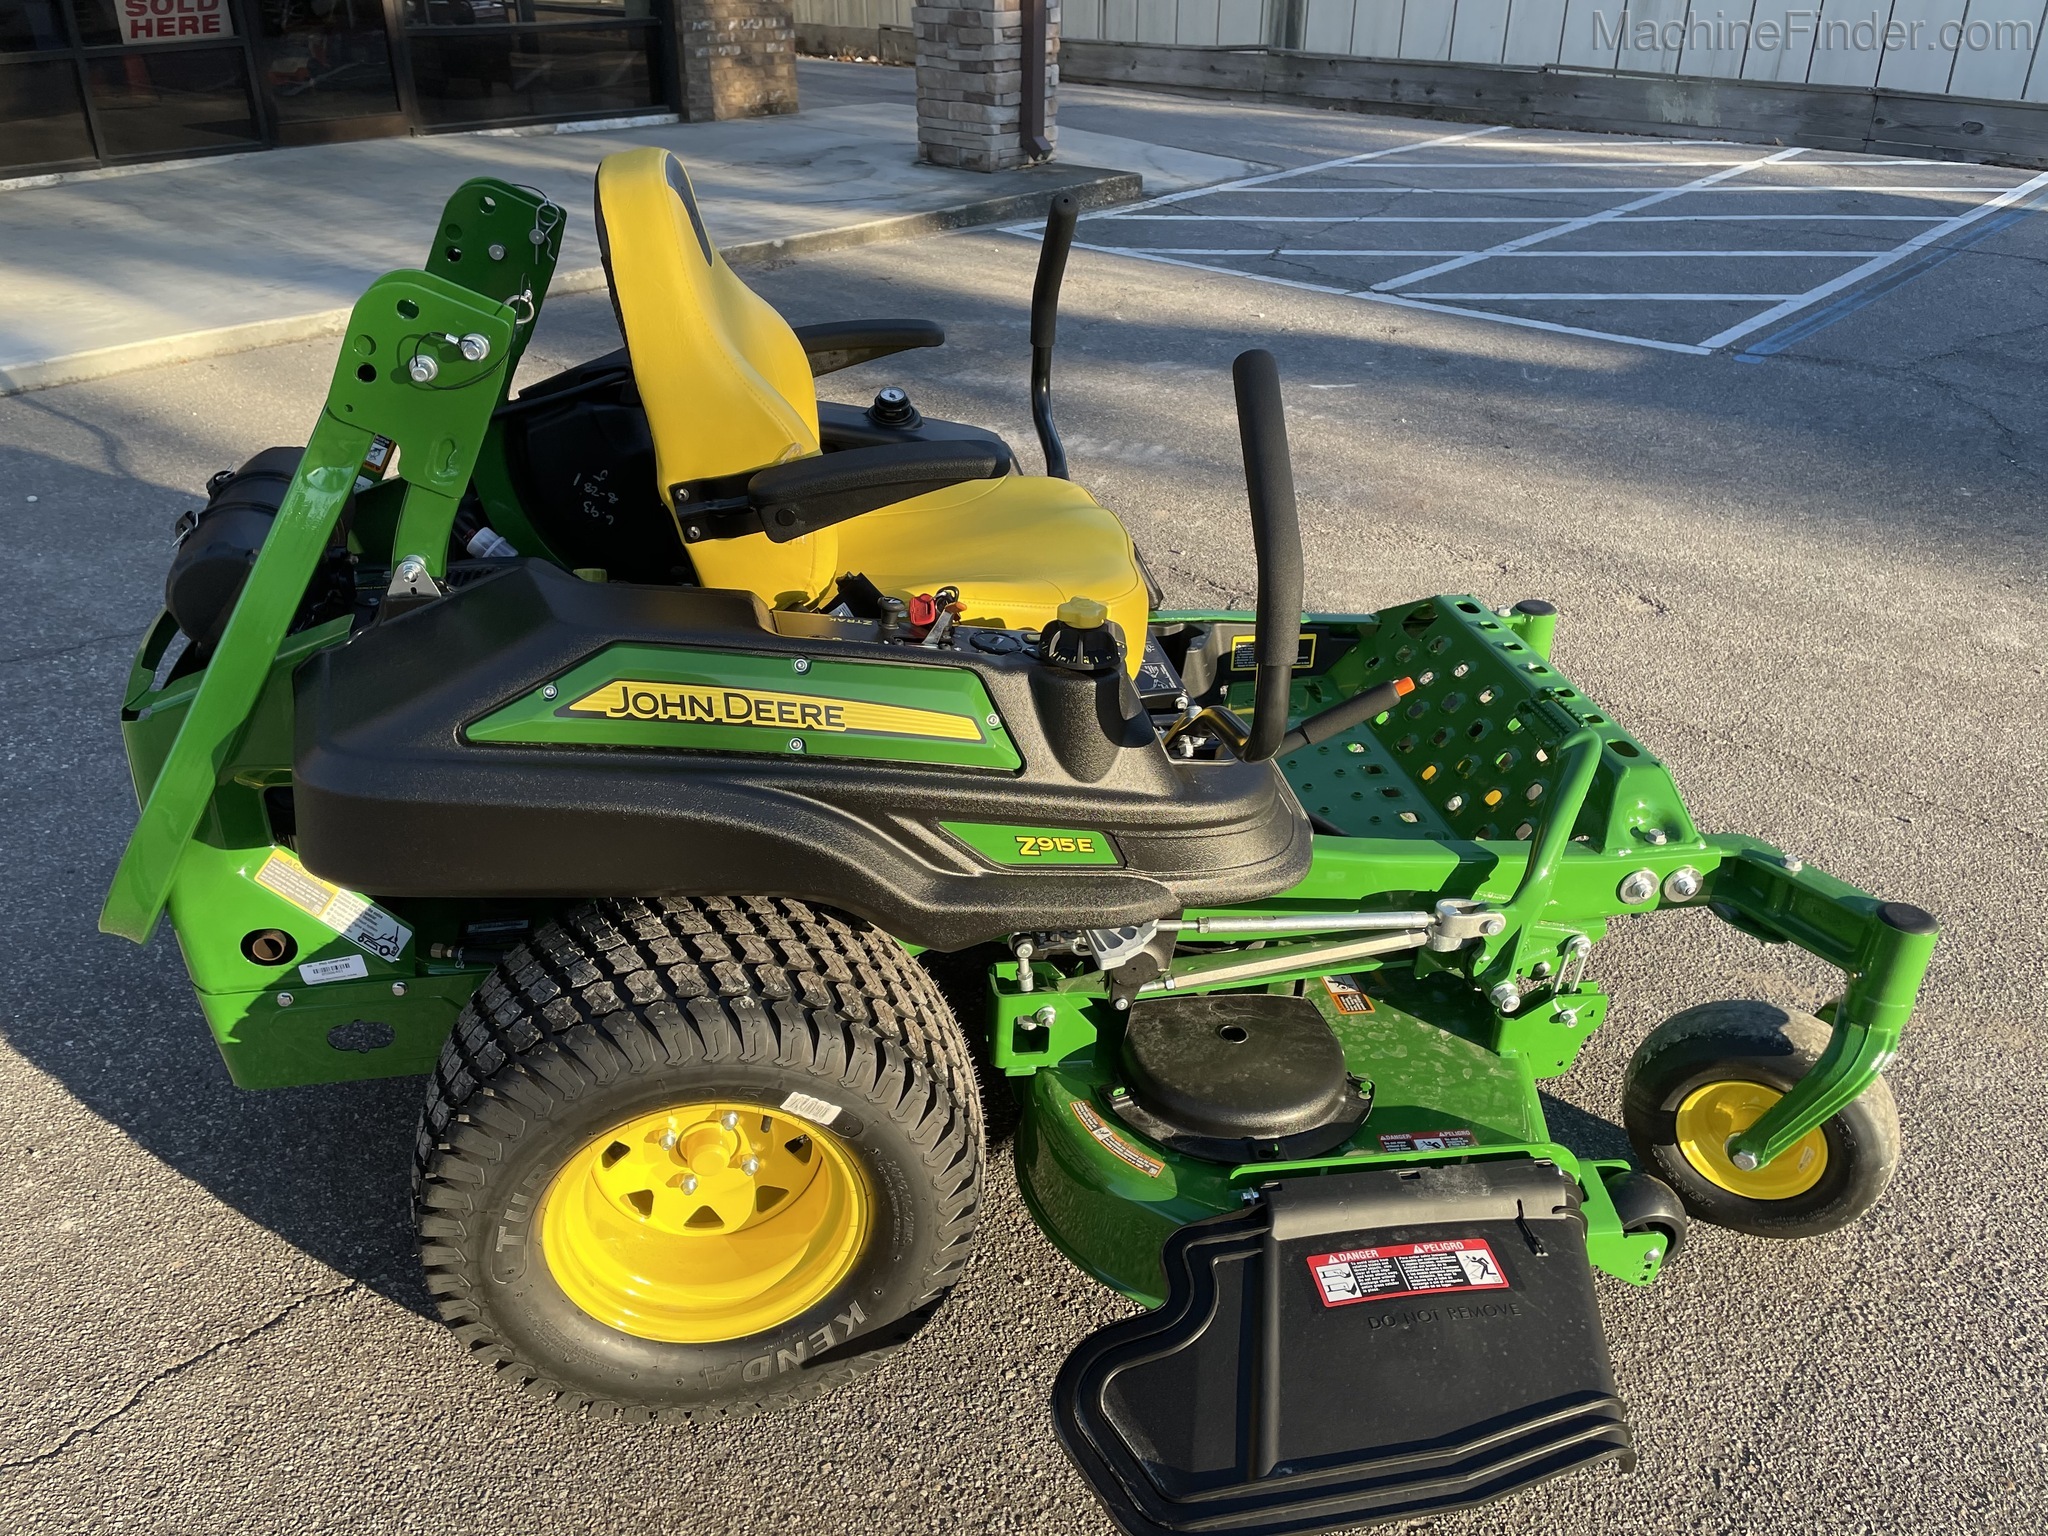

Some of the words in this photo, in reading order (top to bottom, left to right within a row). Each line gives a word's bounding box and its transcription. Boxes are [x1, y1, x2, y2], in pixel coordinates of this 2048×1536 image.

[125, 0, 219, 17] SOLD
[130, 14, 220, 39] HERE
[609, 685, 715, 720] JOHN
[724, 693, 846, 729] DEERE
[1015, 834, 1096, 857] Z915E
[1338, 1249, 1379, 1262] DANGER
[1423, 1241, 1465, 1253] PELIGRO
[1368, 1313, 1396, 1330] DO
[1404, 1308, 1439, 1326] NOT
[1447, 1302, 1522, 1321] REMOVE
[703, 1299, 868, 1390] KENDA
